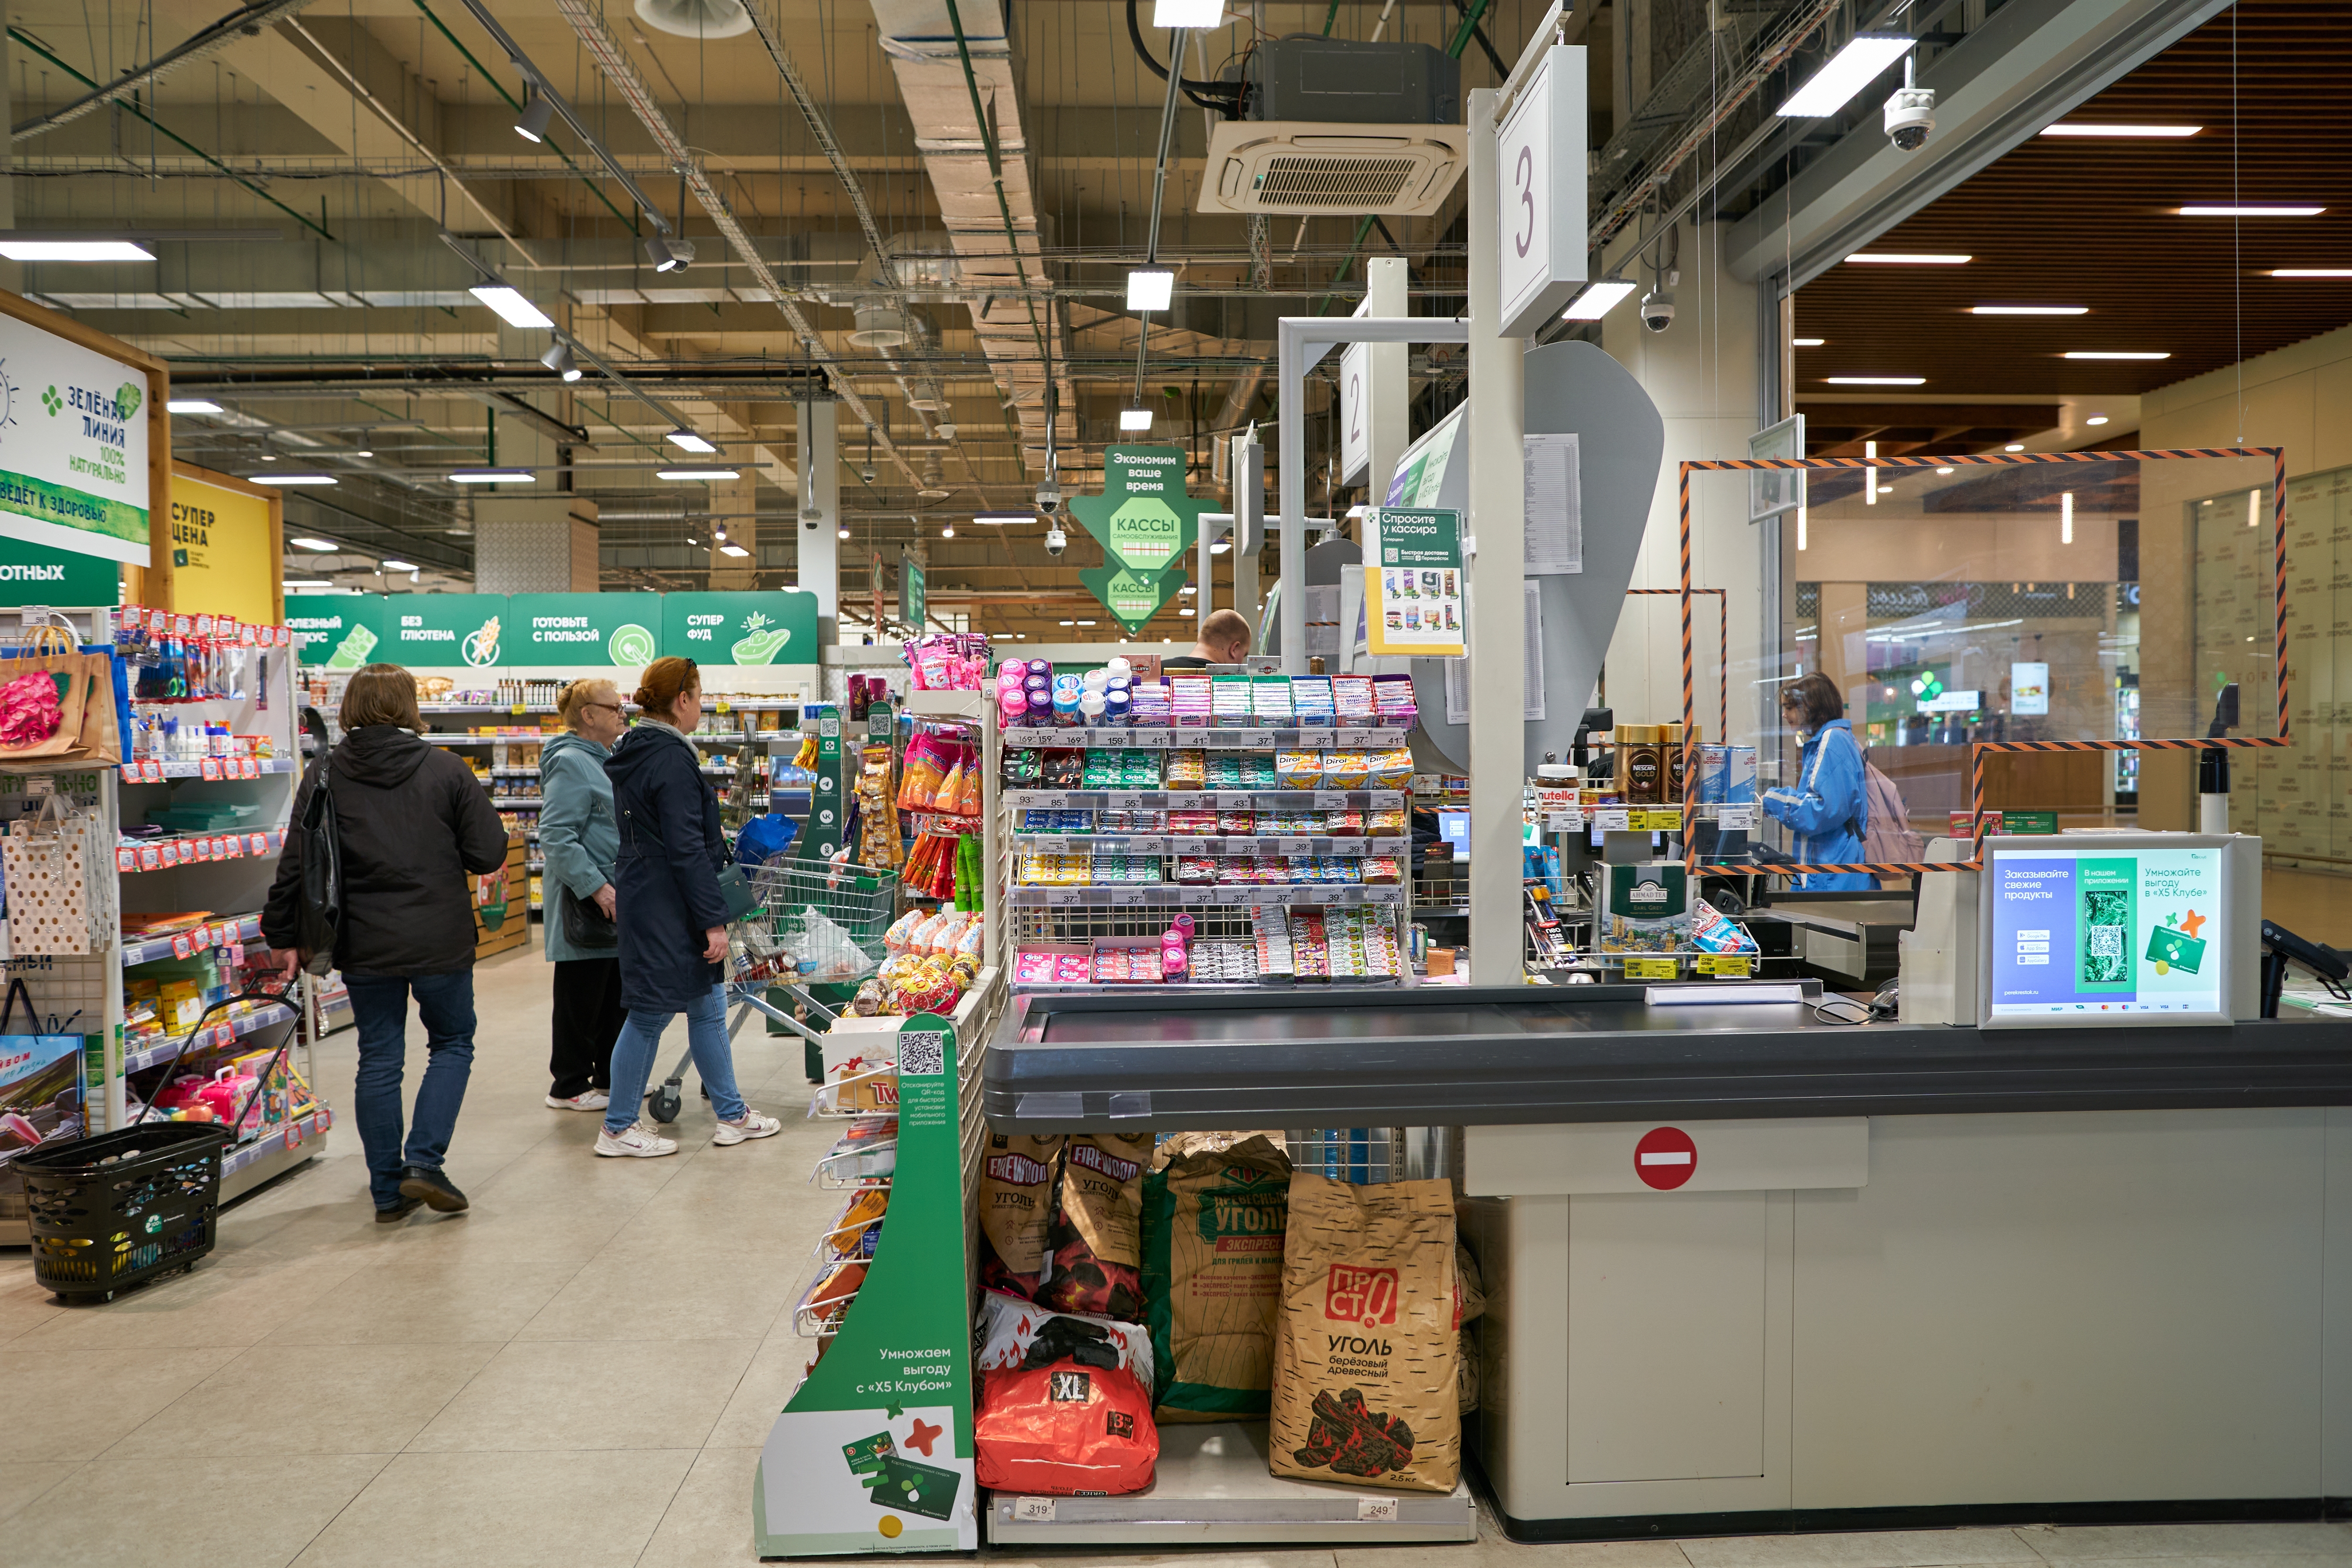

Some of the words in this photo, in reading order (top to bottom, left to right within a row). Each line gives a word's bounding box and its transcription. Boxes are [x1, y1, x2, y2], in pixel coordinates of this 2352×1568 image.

[1515, 144, 1533, 259] 3
[68, 386, 125, 423] ЗЕЛЁНАЯ
[1350, 372, 1361, 444] 2
[82, 415, 125, 448] ЛИНИЯ
[100, 446, 125, 466] 100%
[1113, 453, 1176, 465] Экономим
[70, 454, 125, 484] НАТУРАЛЬНО
[1128, 469, 1162, 477] ваше
[1126, 482, 1163, 492] время
[39, 493, 46, 509] К
[50, 496, 106, 523] ЗДОРОВЬЮ
[172, 503, 215, 527] СУПЕР
[1382, 513, 1436, 525] Спросите
[1117, 518, 1174, 532] КАССЫ
[1382, 525, 1389, 535] у
[1392, 525, 1437, 535] кассира
[172, 524, 208, 547] ЦЕНА
[1113, 583, 1154, 593] КАССЫ
[284, 615, 342, 629] ОЛЕЗНЫЙ
[401, 615, 422, 627] БЕЗ
[532, 617, 588, 628] ГОТОВЬТЕ
[687, 615, 724, 625] СУПЕР
[401, 629, 455, 641] ГЛЮТЕНА
[532, 631, 542, 642] С
[544, 629, 599, 642] ПОЛЬЗОЙ
[687, 629, 712, 640] ФУД
[924, 747, 946, 766] mentos
[1025, 765, 1034, 776] 5
[1539, 790, 1575, 800] nutella
[2004, 870, 2069, 879] Заказывайте
[2004, 891, 2052, 901] продукты
[2173, 888, 2207, 898] Клубе»
[1074, 1146, 1136, 1181] FIREWOOD
[990, 1156, 1046, 1184] FIREWOOD
[995, 1193, 1035, 1206] УГОЛЬ
[1226, 1238, 1281, 1250] ЭКСПРЕСС
[1328, 1335, 1392, 1356] УГОЛЬ
[879, 1348, 951, 1360] Умножаем
[1329, 1355, 1388, 1368] берёзовый
[903, 1365, 951, 1376] выгоду
[1327, 1366, 1388, 1378] древесный
[856, 1385, 864, 1393] с
[895, 1380, 952, 1394] Клубом»
[1058, 1375, 1084, 1399] XL
[1114, 1414, 1123, 1428] 3
[1124, 1423, 1130, 1431] kg
[905, 1463, 935, 1473] персональных
[925, 1510, 947, 1518] Перекрёсток
[1029, 1504, 1047, 1514] 319
[1370, 1505, 1388, 1515] 249
